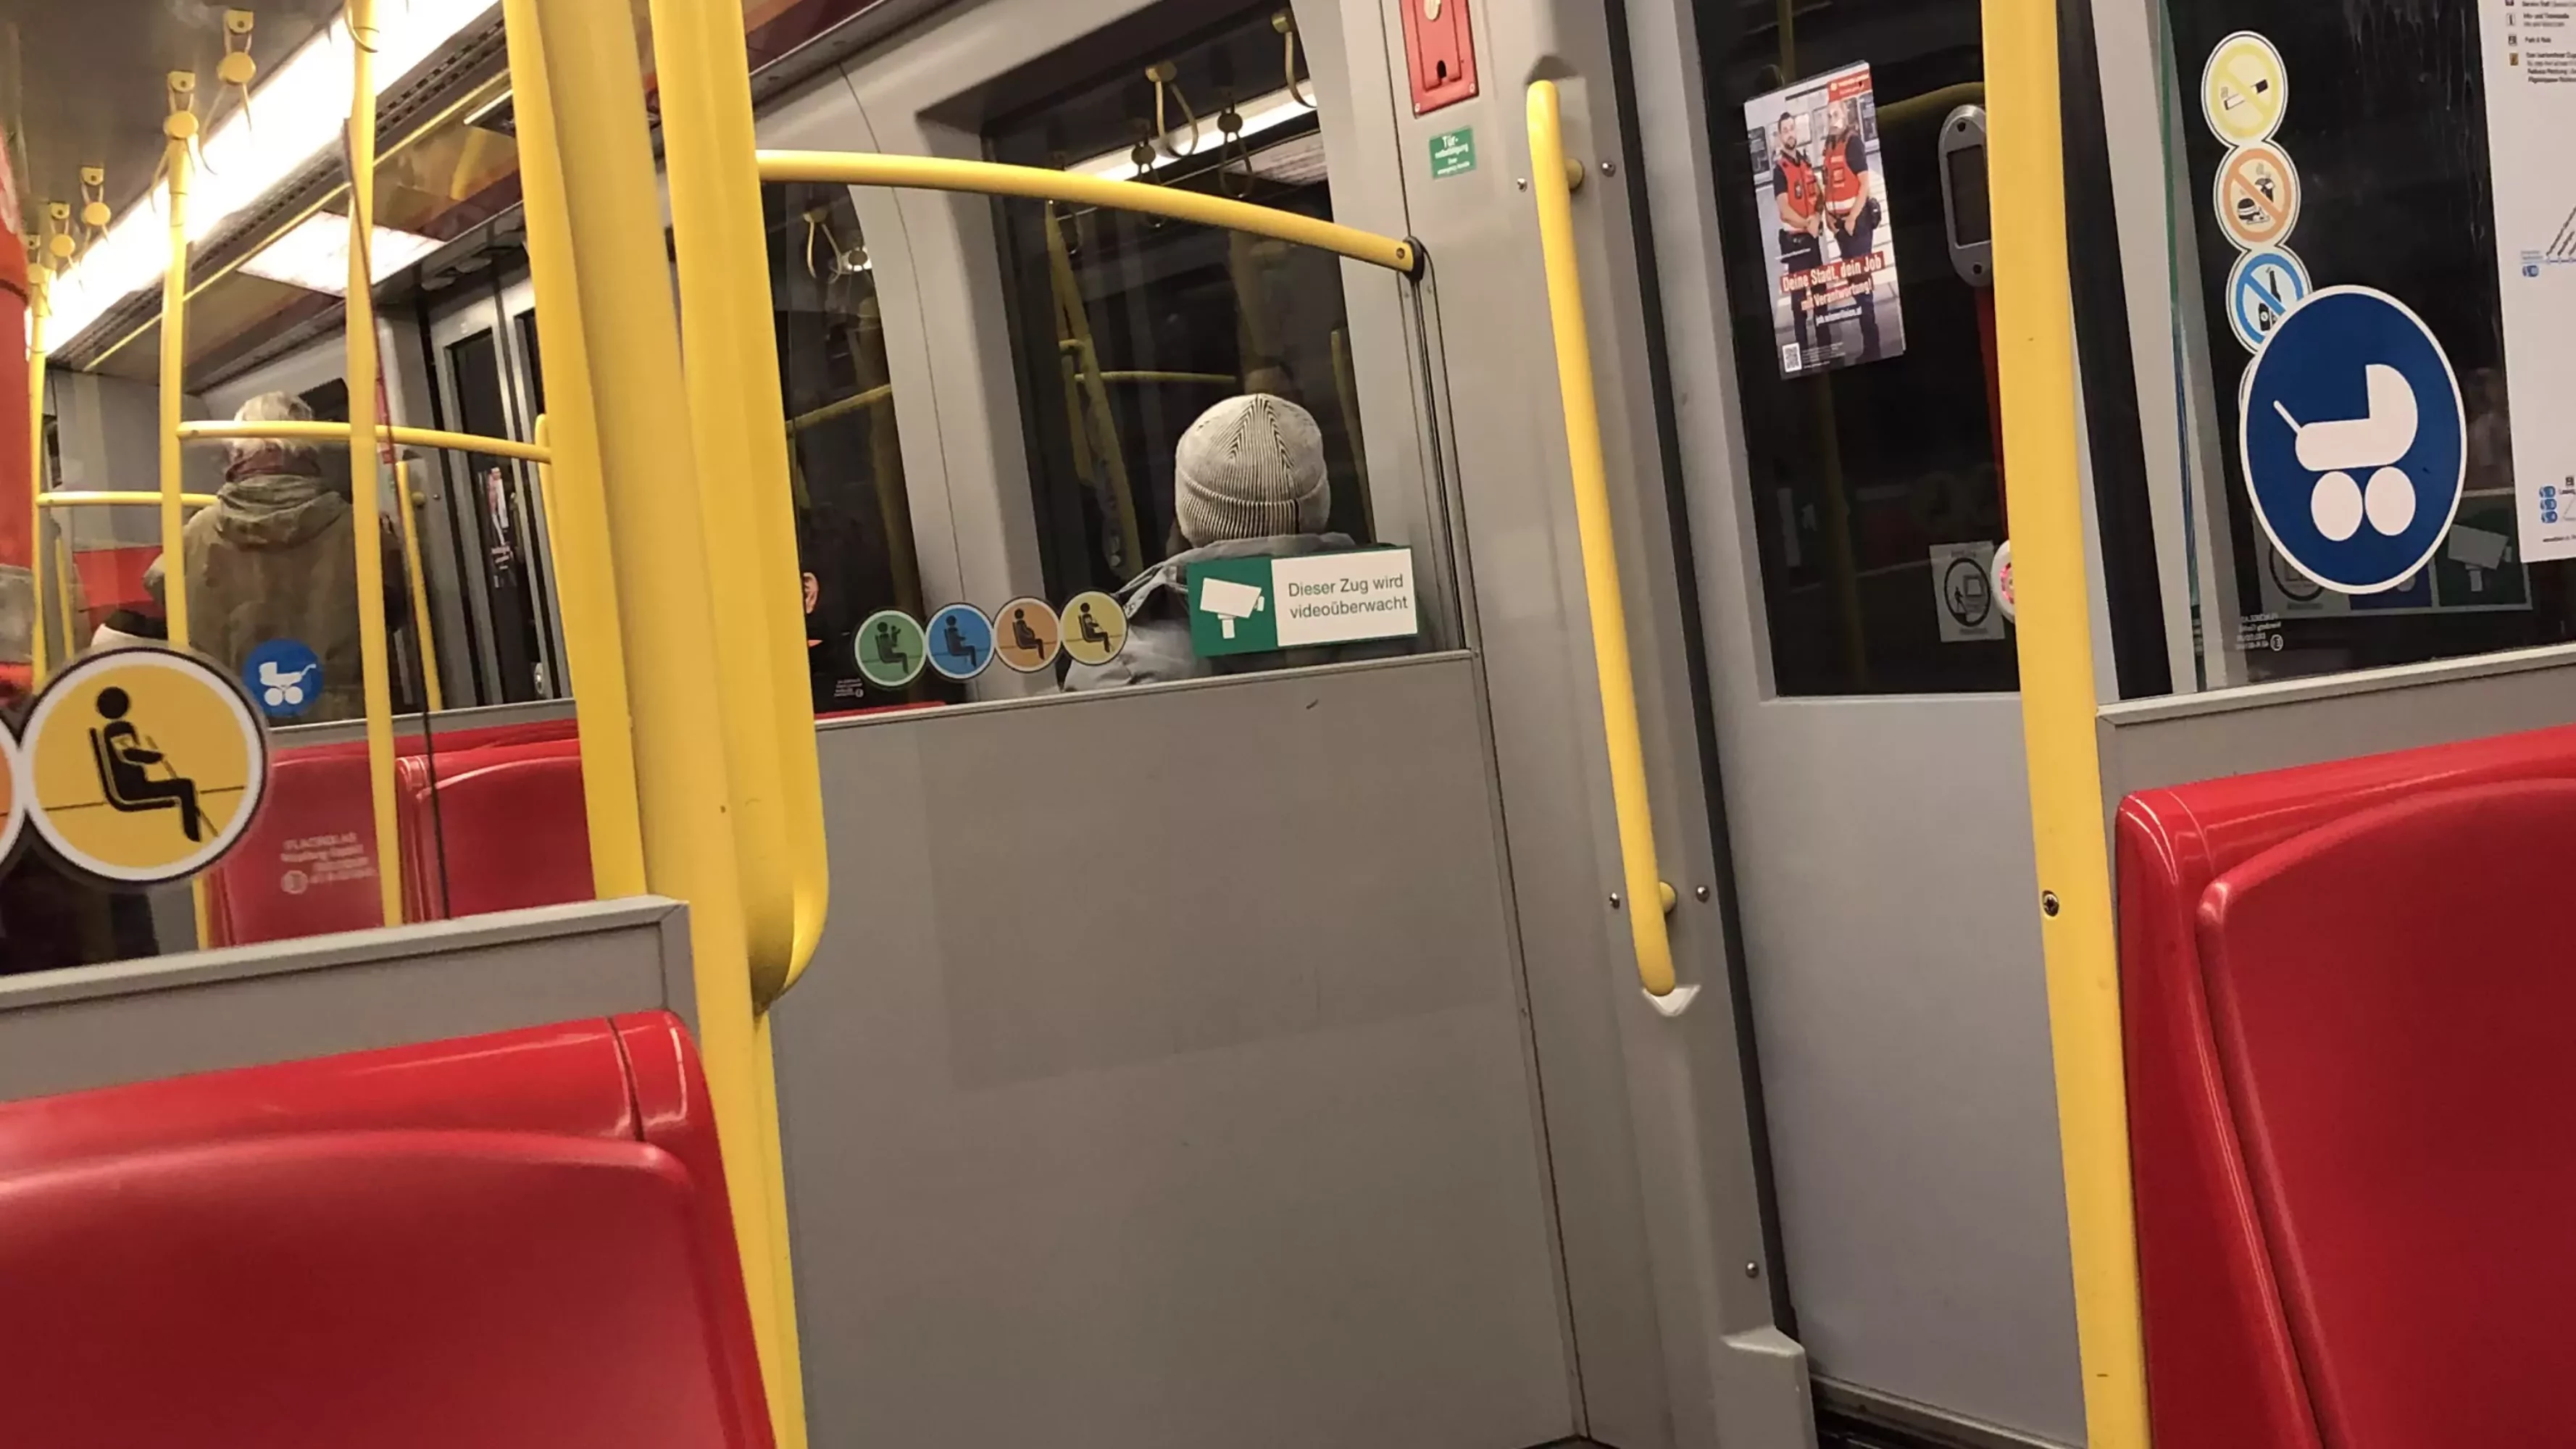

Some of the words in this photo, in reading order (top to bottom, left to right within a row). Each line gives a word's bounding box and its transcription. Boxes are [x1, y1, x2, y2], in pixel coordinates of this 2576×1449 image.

[1783, 274, 1809, 291] Deine
[1810, 264, 1839, 285] Stadt,
[1841, 260, 1862, 277] dein
[1863, 254, 1882, 272] Job
[1288, 582, 1335, 597] Dieser
[1340, 579, 1368, 594] Zug
[1372, 574, 1404, 589] wird
[1290, 596, 1408, 618] videoüberwacht
